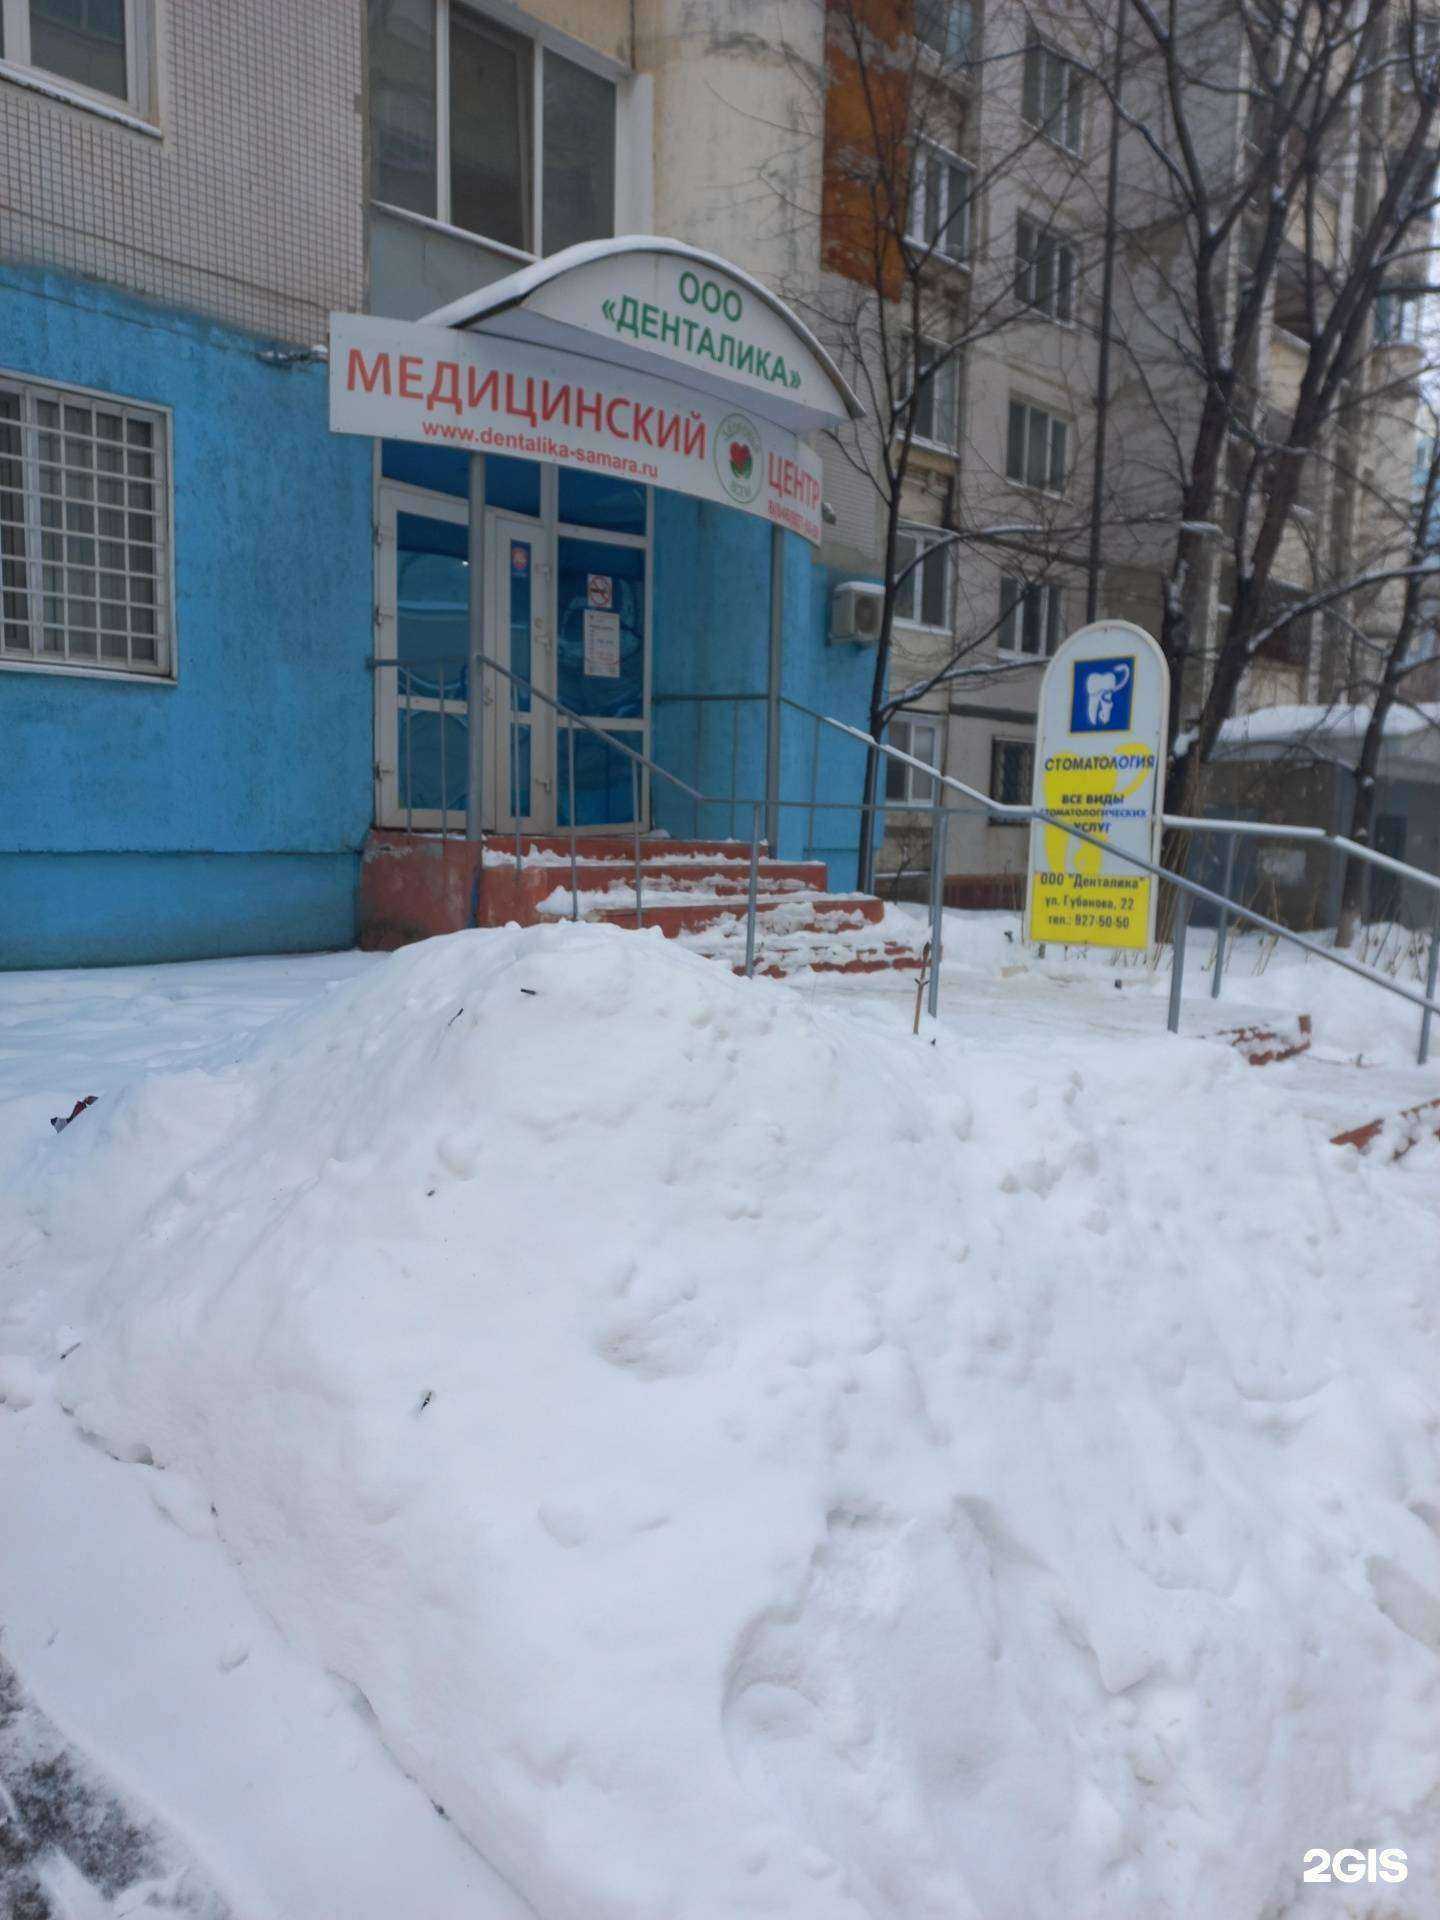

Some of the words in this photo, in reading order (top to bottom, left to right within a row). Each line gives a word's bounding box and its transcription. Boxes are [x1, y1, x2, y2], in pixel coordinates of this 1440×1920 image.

[678, 270, 744, 322] ООО
[601, 294, 802, 390] «ДЕНТАЛИКА»
[346, 347, 706, 460] МЕДИЦИНСКИЙ
[767, 451, 821, 511] ЦЕНТР
[422, 420, 659, 479] www.dentalika-samara.ru
[1044, 755, 1155, 771] СТОМАТОЛОГИЯ
[1062, 794, 1083, 804] ВСЕ
[1086, 794, 1124, 805] ВИДЫ
[1040, 873, 1064, 886] ООО
[1045, 895, 1060, 907] ул.
[1121, 897, 1134, 911] 22
